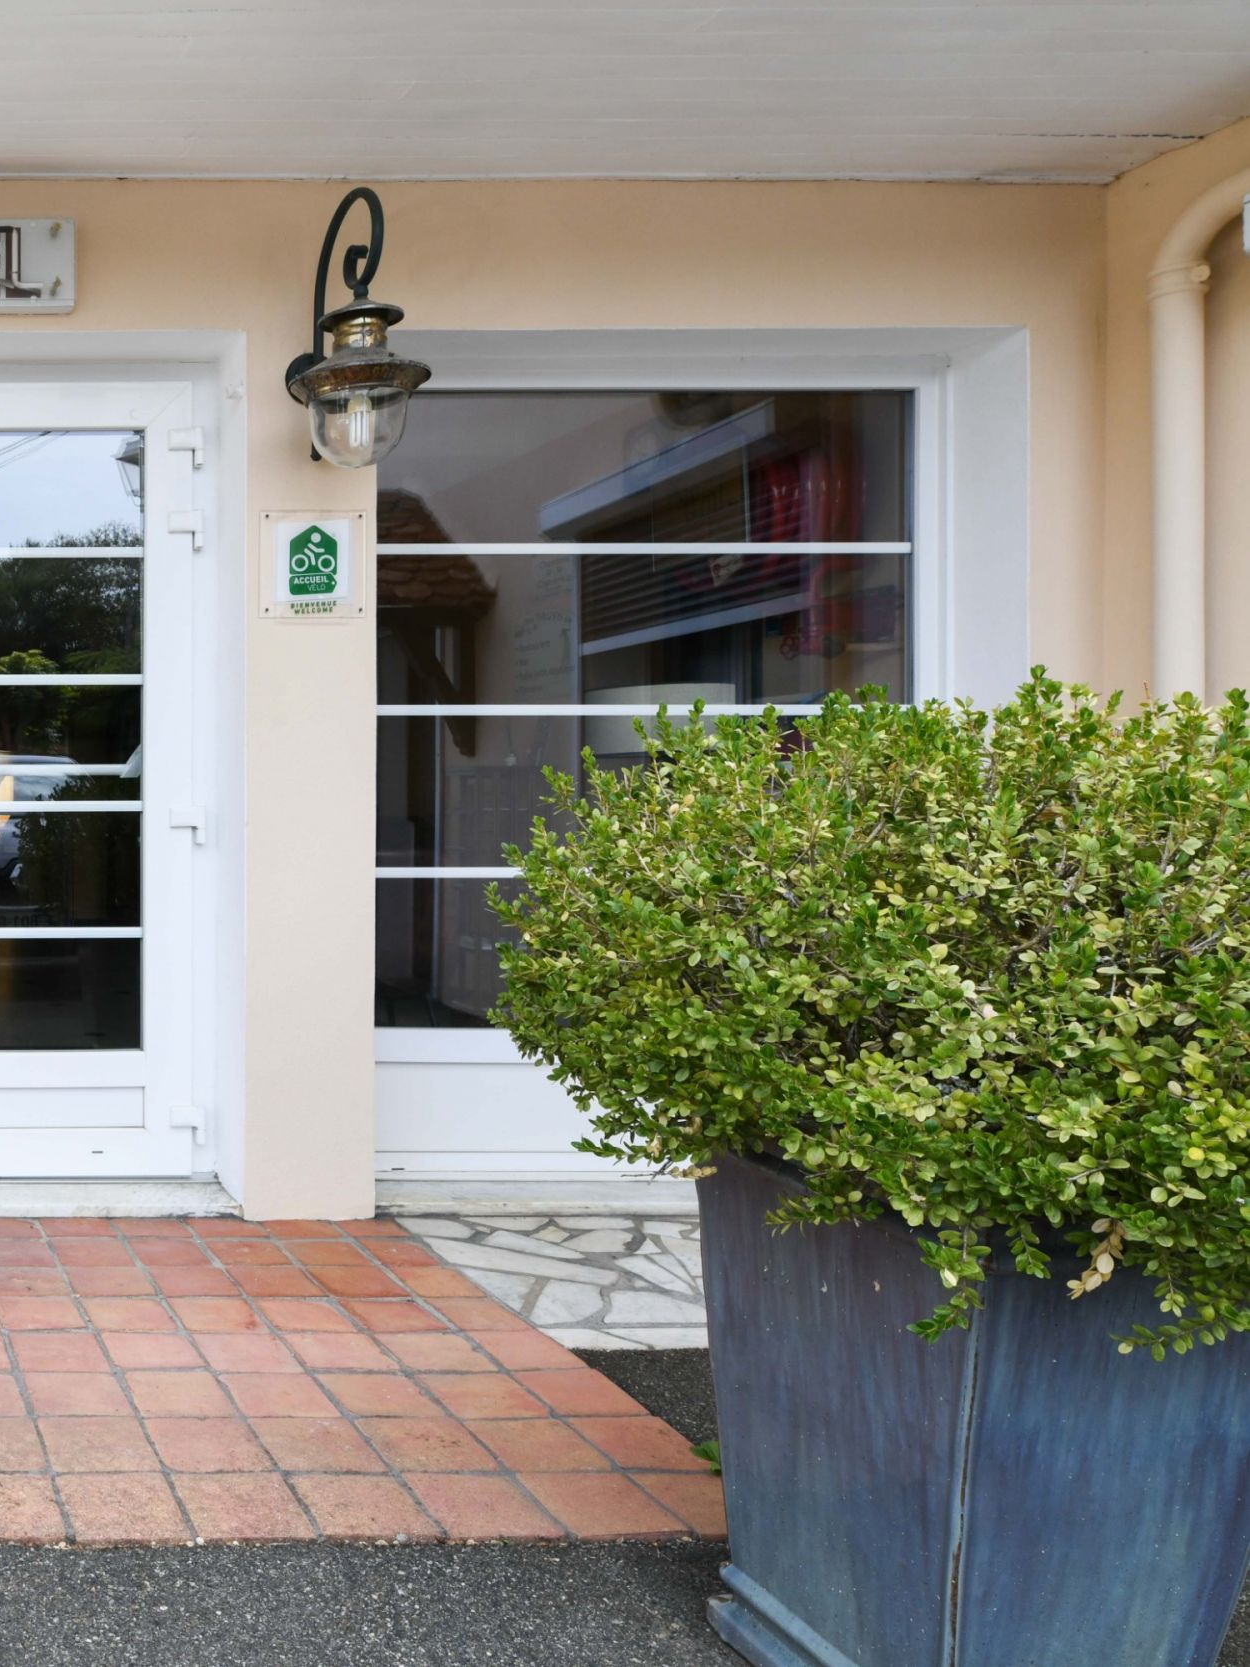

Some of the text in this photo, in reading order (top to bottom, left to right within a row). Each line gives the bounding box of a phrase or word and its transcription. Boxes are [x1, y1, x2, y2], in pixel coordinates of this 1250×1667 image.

[293, 575, 329, 585] ACCUEIL
[290, 600, 337, 609] BIENVENUE
[294, 606, 334, 614] WELCOME
